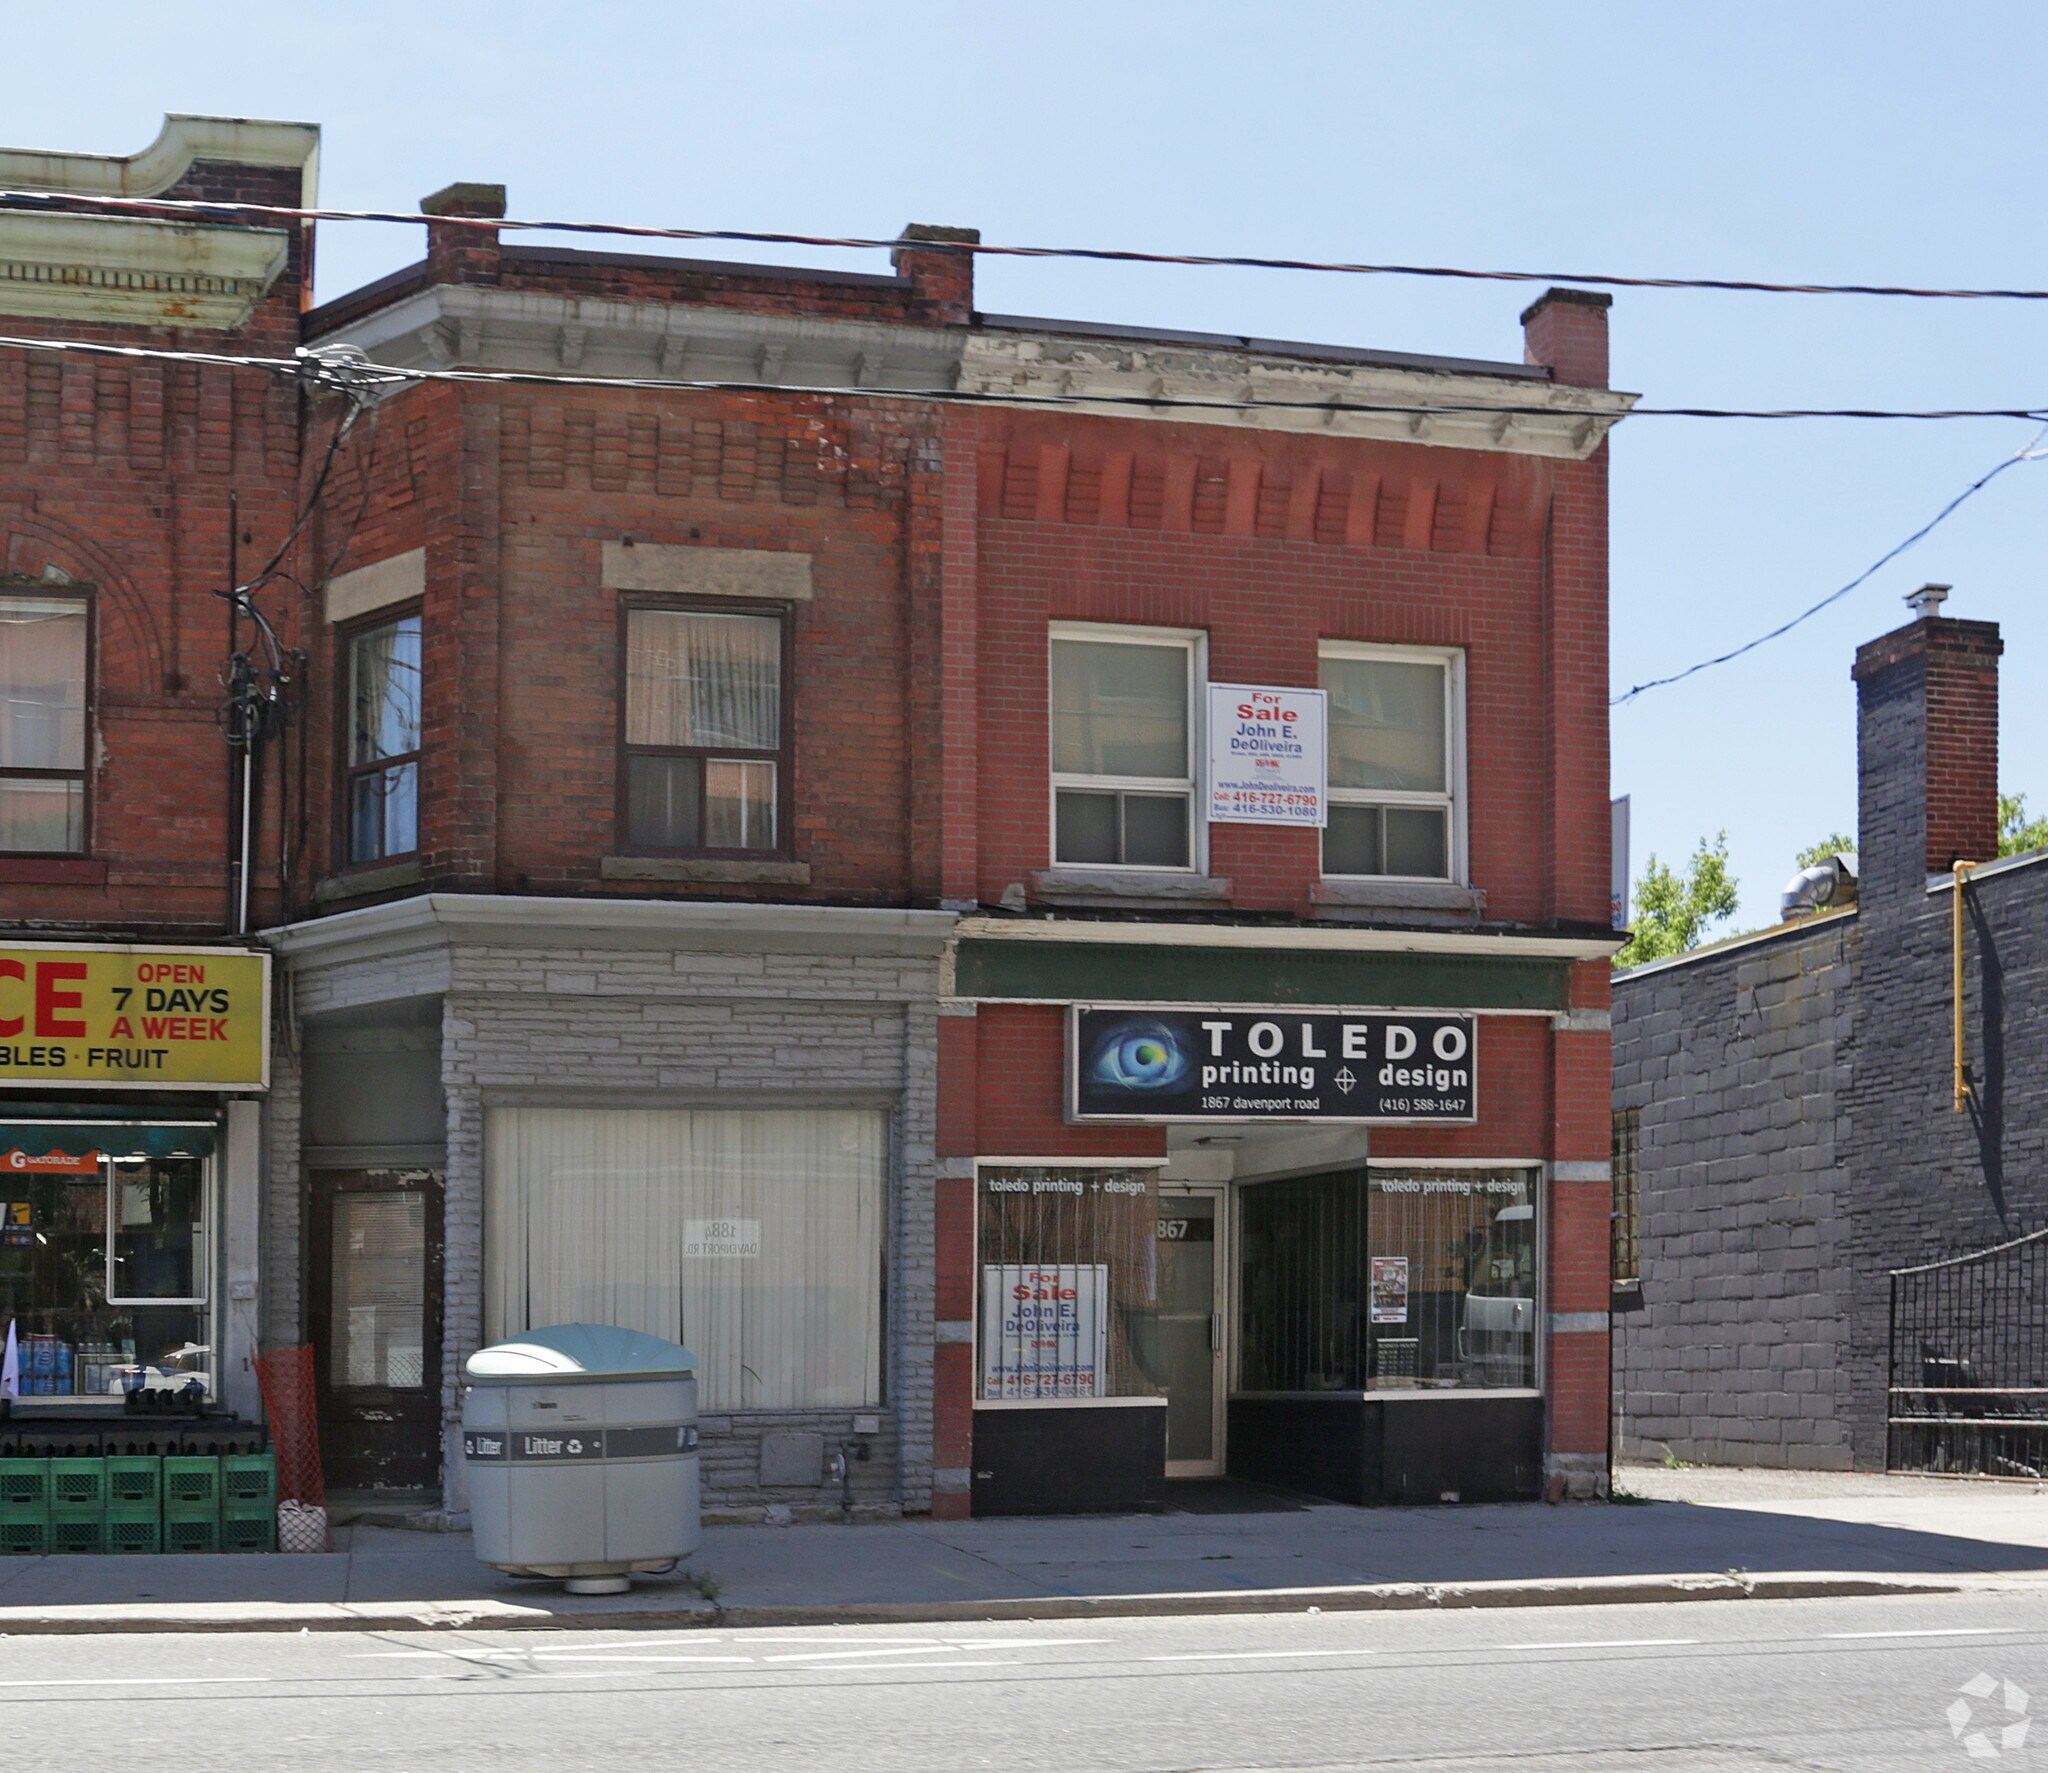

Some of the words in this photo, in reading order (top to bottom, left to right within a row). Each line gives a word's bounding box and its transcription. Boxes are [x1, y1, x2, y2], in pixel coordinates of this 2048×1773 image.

[1252, 692, 1282, 704] For
[1237, 704, 1298, 722] Sale
[1236, 723, 1276, 738] John
[1282, 725, 1297, 739] E.
[1231, 738, 1302, 753] DeOliveira
[1233, 791, 1317, 806] 416-727-6790
[1233, 803, 1317, 816] 416-530-1080
[137, 963, 205, 984] OPEN
[111, 988, 133, 1011] 7
[146, 988, 229, 1013] DAYS
[109, 1016, 134, 1039] A
[141, 1017, 228, 1041] WEEK
[1201, 1020, 1467, 1061] TOLEDO
[88, 1048, 168, 1069] FRUIT
[1202, 1061, 1315, 1089] printing
[1378, 1063, 1468, 1092] design
[1201, 1096, 1230, 1110] 1867
[1233, 1096, 1292, 1111] davenport
[1294, 1097, 1320, 1110] road
[1378, 1098, 1411, 1113] (416)
[1413, 1098, 1466, 1112] 588-1647
[27, 1155, 80, 1165] GATORADE
[989, 1178, 1029, 1192] toledo
[1032, 1178, 1084, 1195] printing
[1104, 1178, 1146, 1196] design
[1381, 1178, 1420, 1193] toledo
[1423, 1178, 1471, 1196] printing
[1487, 1178, 1526, 1196] design
[1029, 1272, 1060, 1283] For
[1012, 1284, 1077, 1300] Sale
[1012, 1304, 1053, 1317] John
[1060, 1304, 1076, 1317] E.
[1006, 1320, 1080, 1332] DeOliveira
[477, 1437, 502, 1455] Litter
[524, 1436, 563, 1455] Litter
